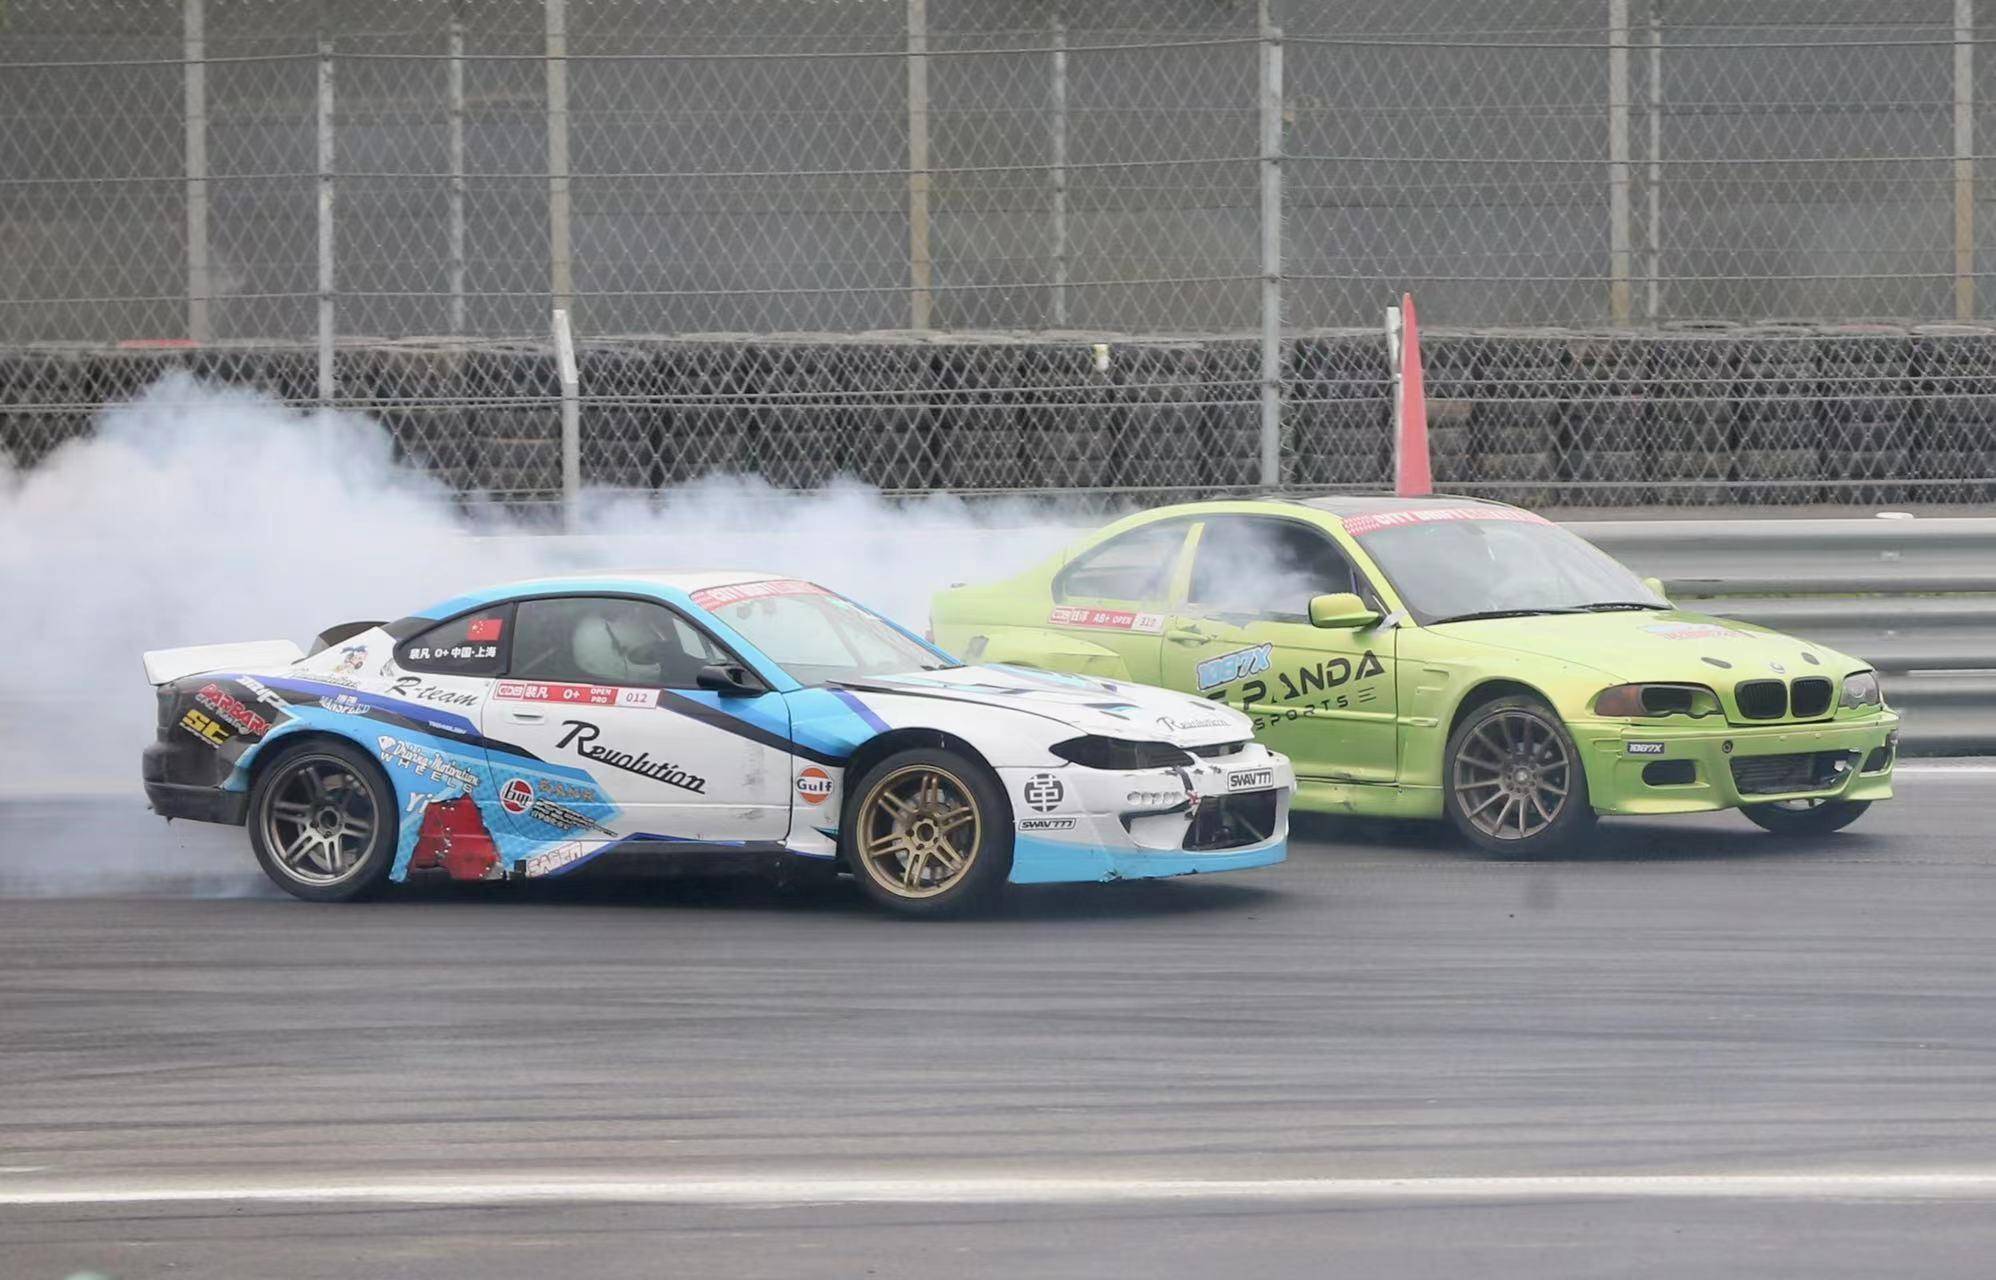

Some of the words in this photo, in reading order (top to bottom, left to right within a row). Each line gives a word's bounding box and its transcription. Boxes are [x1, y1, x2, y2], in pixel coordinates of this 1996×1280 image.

[625, 692, 648, 703] 012
[1253, 695, 1349, 732] SPORTS
[555, 720, 706, 795] Revolution
[796, 778, 833, 793] Gulf
